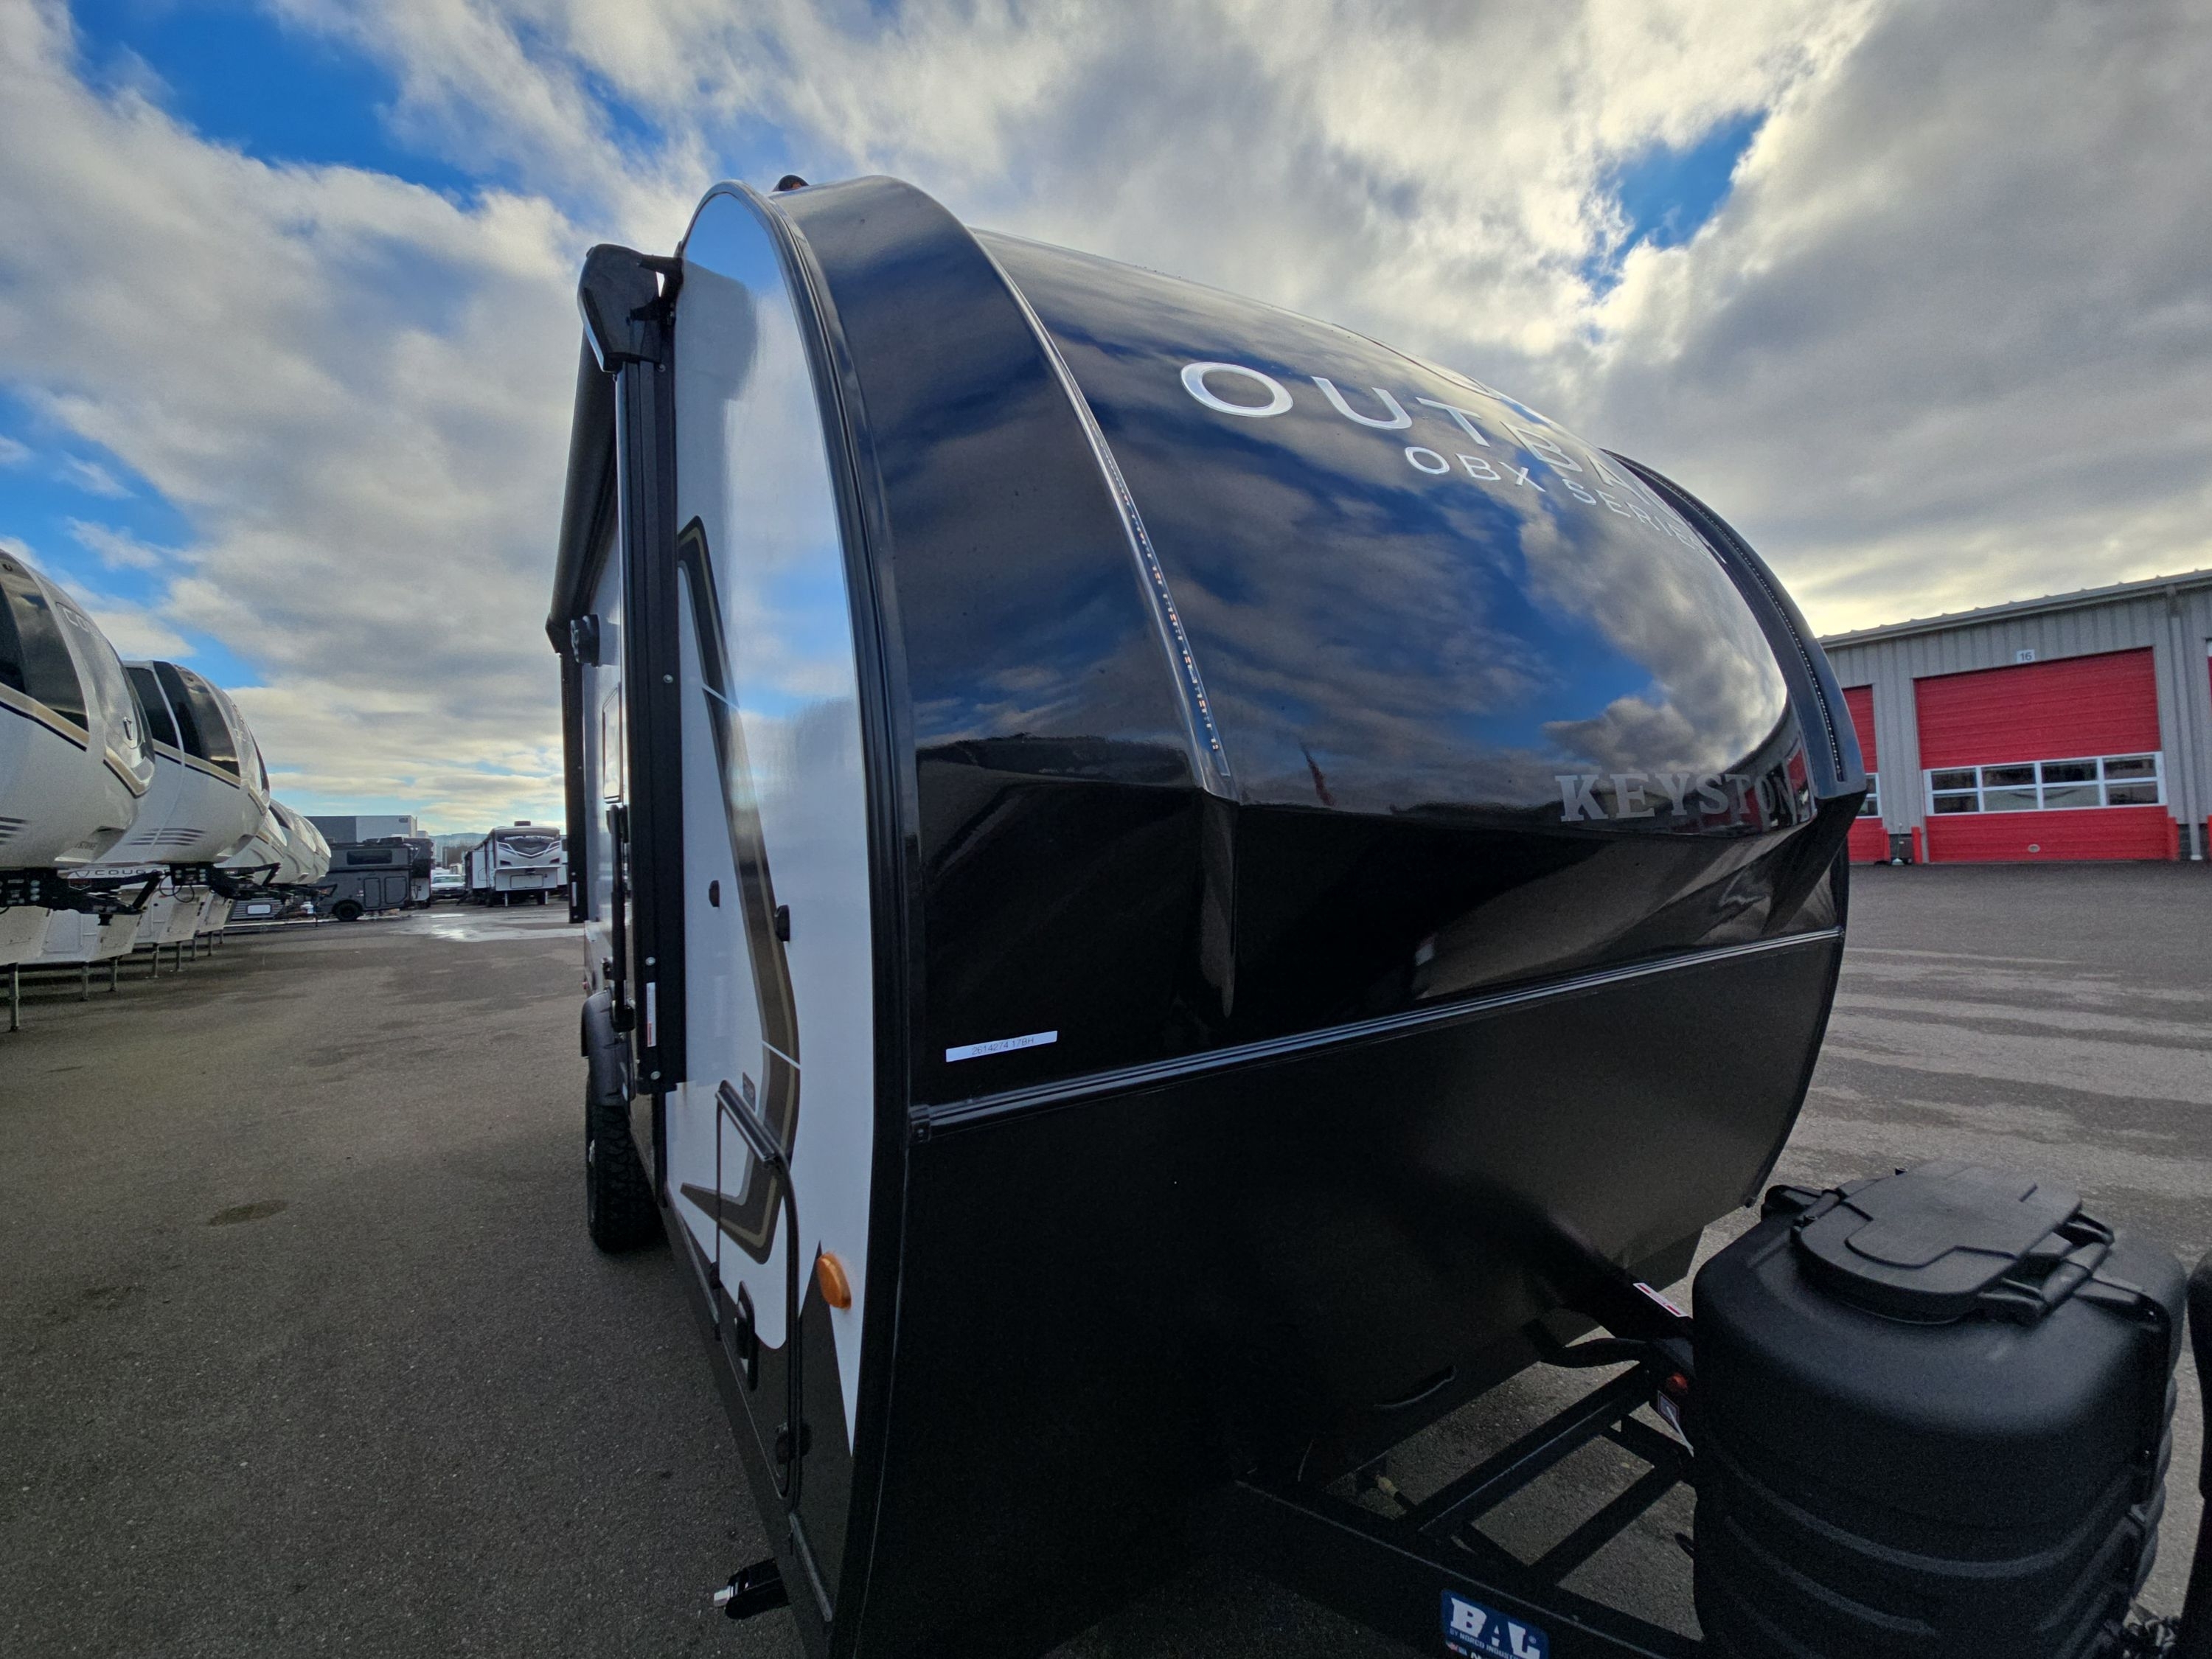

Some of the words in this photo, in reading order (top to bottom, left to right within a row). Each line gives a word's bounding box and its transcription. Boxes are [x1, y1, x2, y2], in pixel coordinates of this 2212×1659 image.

[1181, 361, 1726, 564] OUTBAC
[1405, 446, 1546, 493] OBX
[1562, 478, 1711, 561] SERIES
[2019, 652, 2033, 661] 16
[1555, 772, 1806, 826] KEYSTON
[972, 1041, 1009, 1055] 2614274
[1012, 1037, 1034, 1048] 17BH
[1450, 1597, 1540, 1659] BAL
